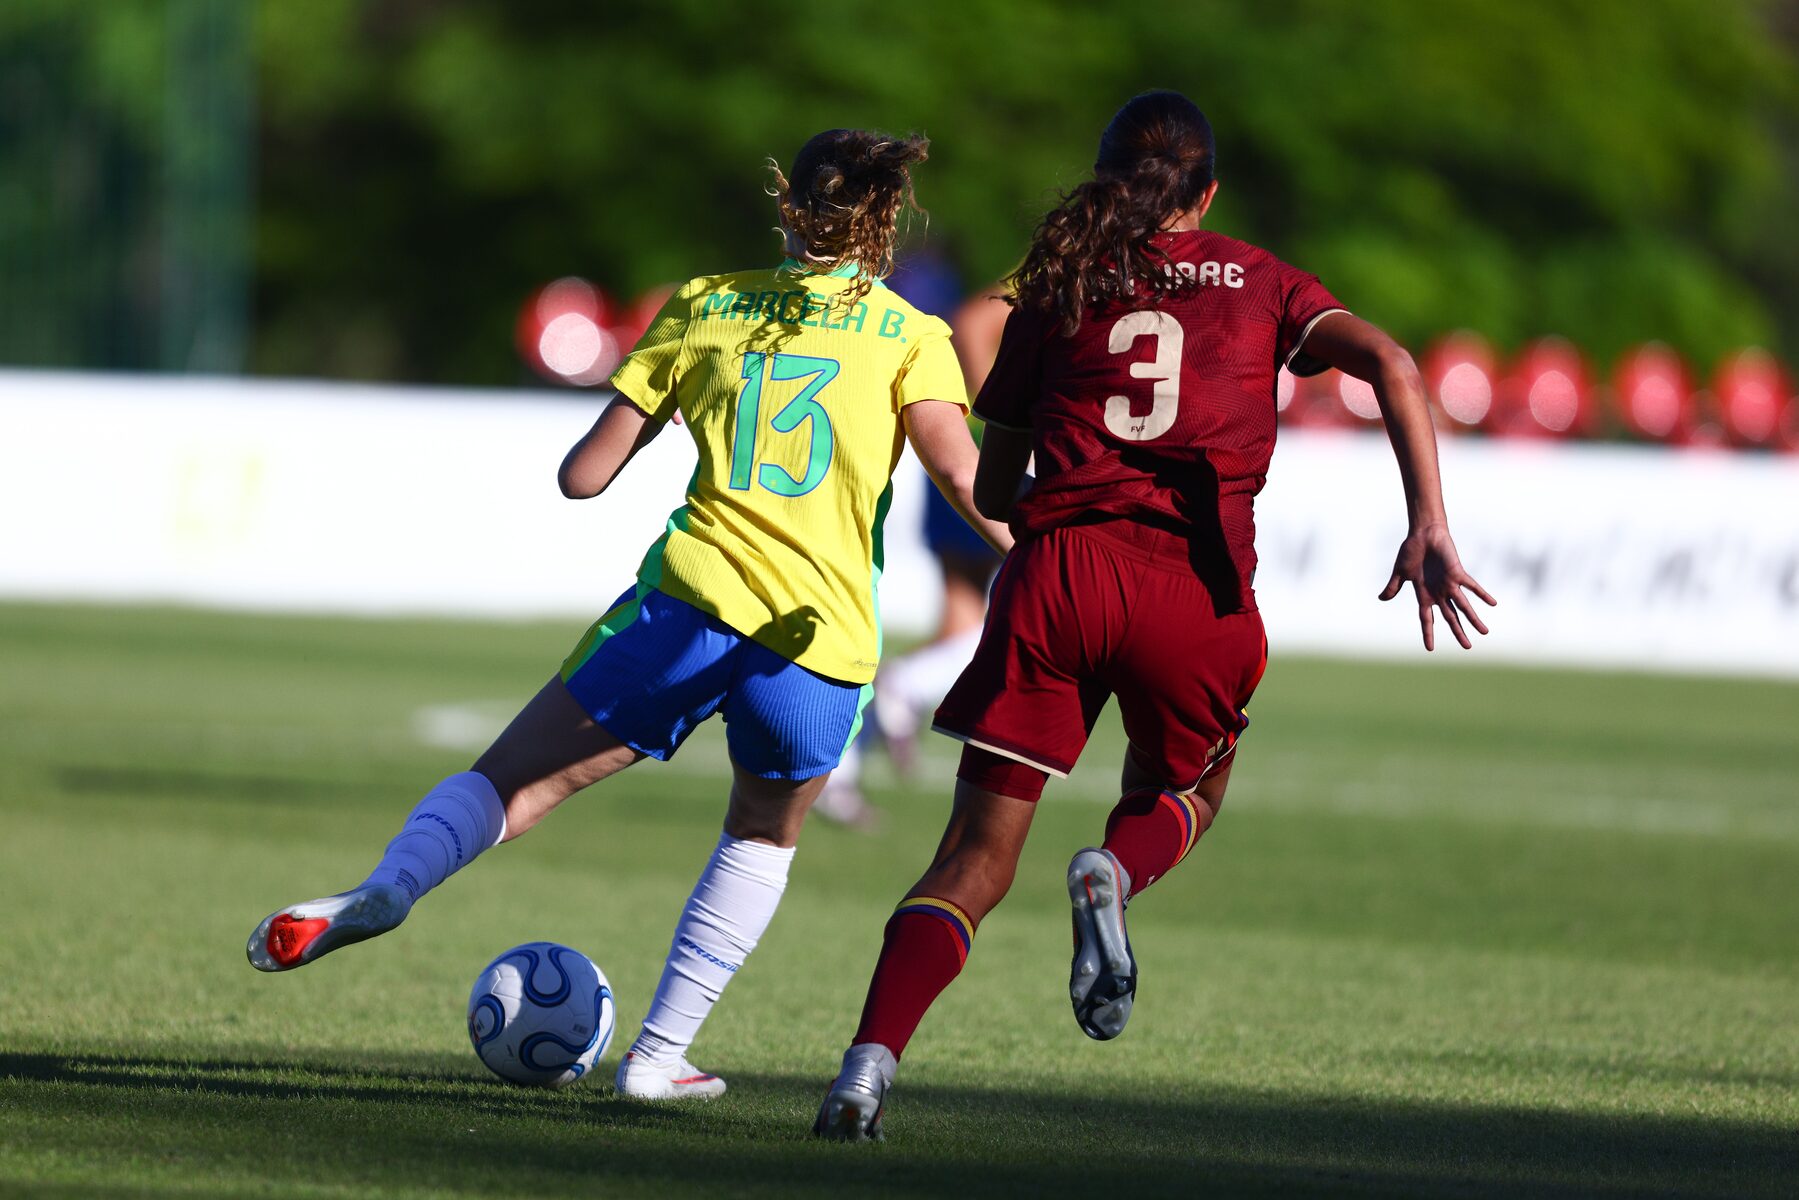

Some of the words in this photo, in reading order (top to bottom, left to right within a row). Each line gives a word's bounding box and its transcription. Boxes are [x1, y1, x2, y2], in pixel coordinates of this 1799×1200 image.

[702, 290, 868, 333] MARCELA
[878, 308, 907, 344] B.
[1103, 310, 1185, 441] 3
[729, 351, 840, 497] 13
